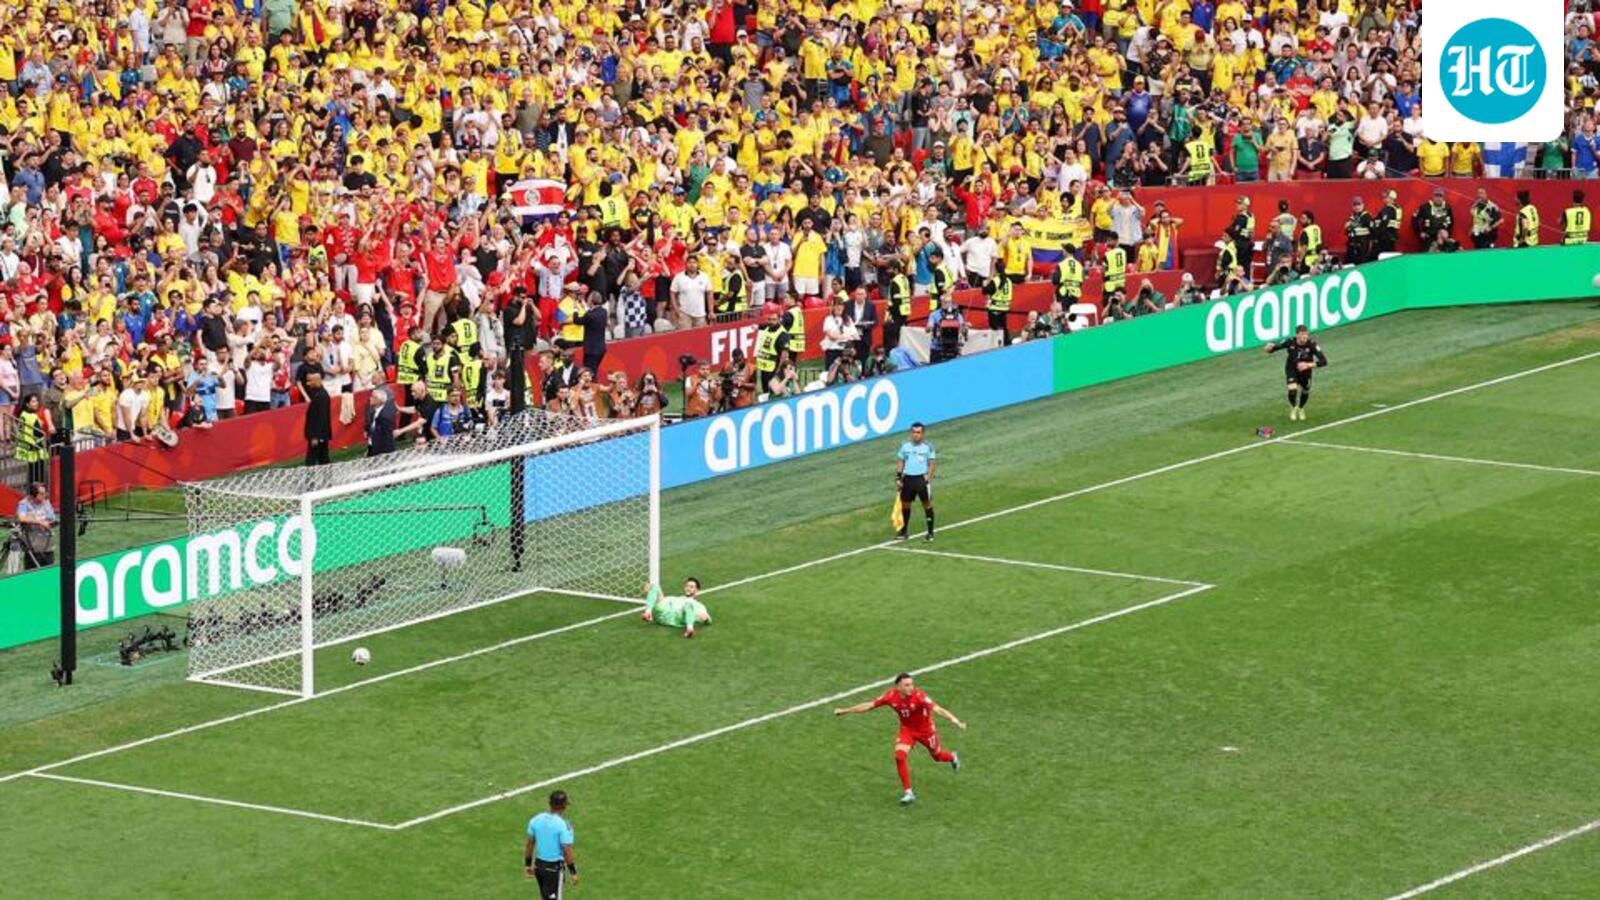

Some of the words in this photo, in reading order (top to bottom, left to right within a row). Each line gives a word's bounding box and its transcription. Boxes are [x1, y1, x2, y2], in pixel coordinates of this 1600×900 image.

[1206, 270, 1368, 352] aramco
[704, 378, 899, 473] aramco
[75, 515, 317, 625] aramco
